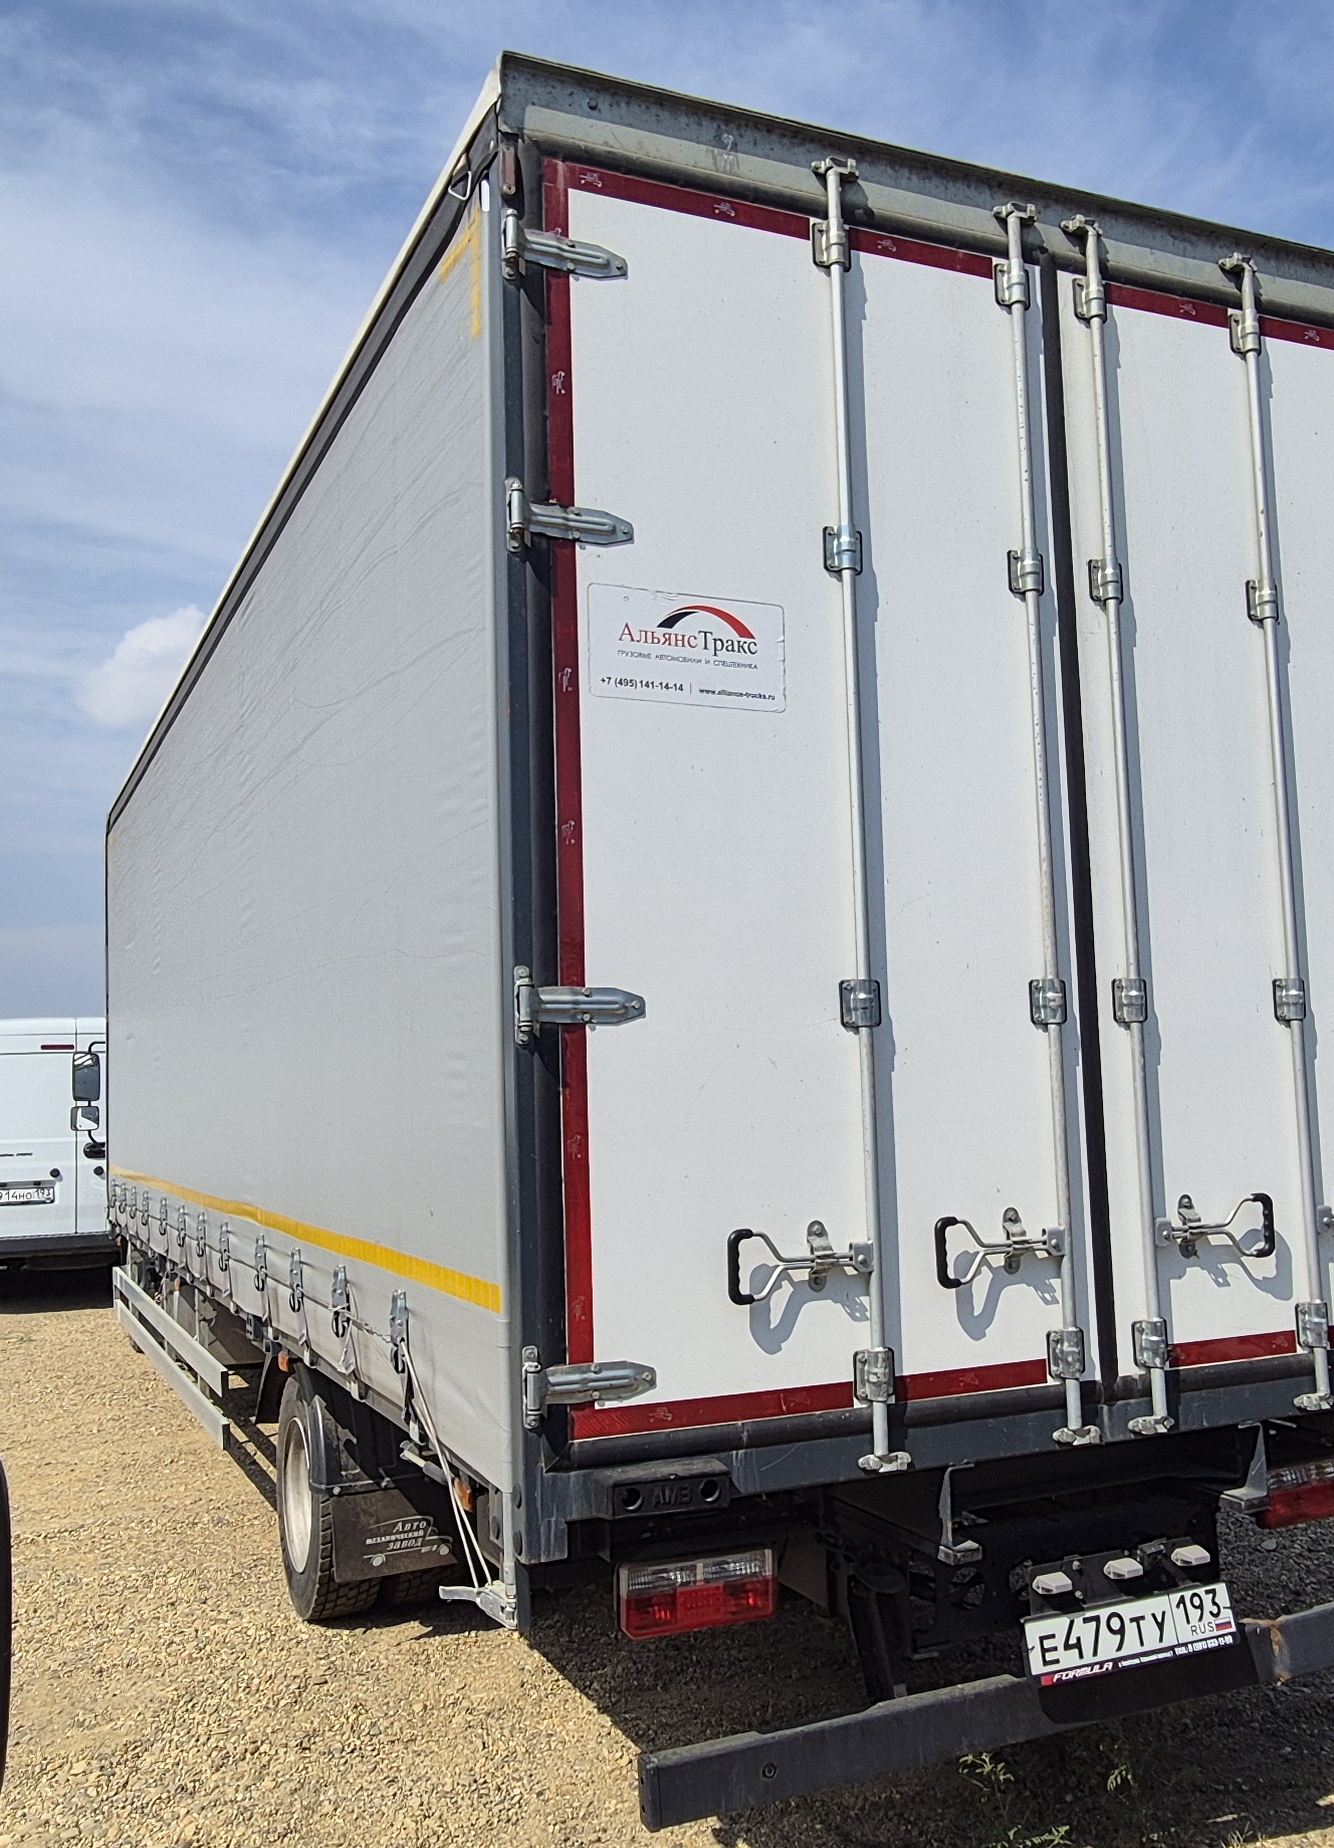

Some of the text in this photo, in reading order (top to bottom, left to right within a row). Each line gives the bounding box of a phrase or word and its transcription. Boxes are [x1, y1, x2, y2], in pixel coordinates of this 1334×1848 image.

[618, 622, 758, 656] АльянсТракс
[600, 677, 612, 686] +7
[614, 677, 638, 690] (495)
[639, 679, 684, 692] 141-14-14
[1038, 1610, 1167, 1667] Е479ТУ
[1175, 1587, 1222, 1626] 193
[1190, 1622, 1215, 1637] RUS
[1053, 1661, 1114, 1683] FORMULA
